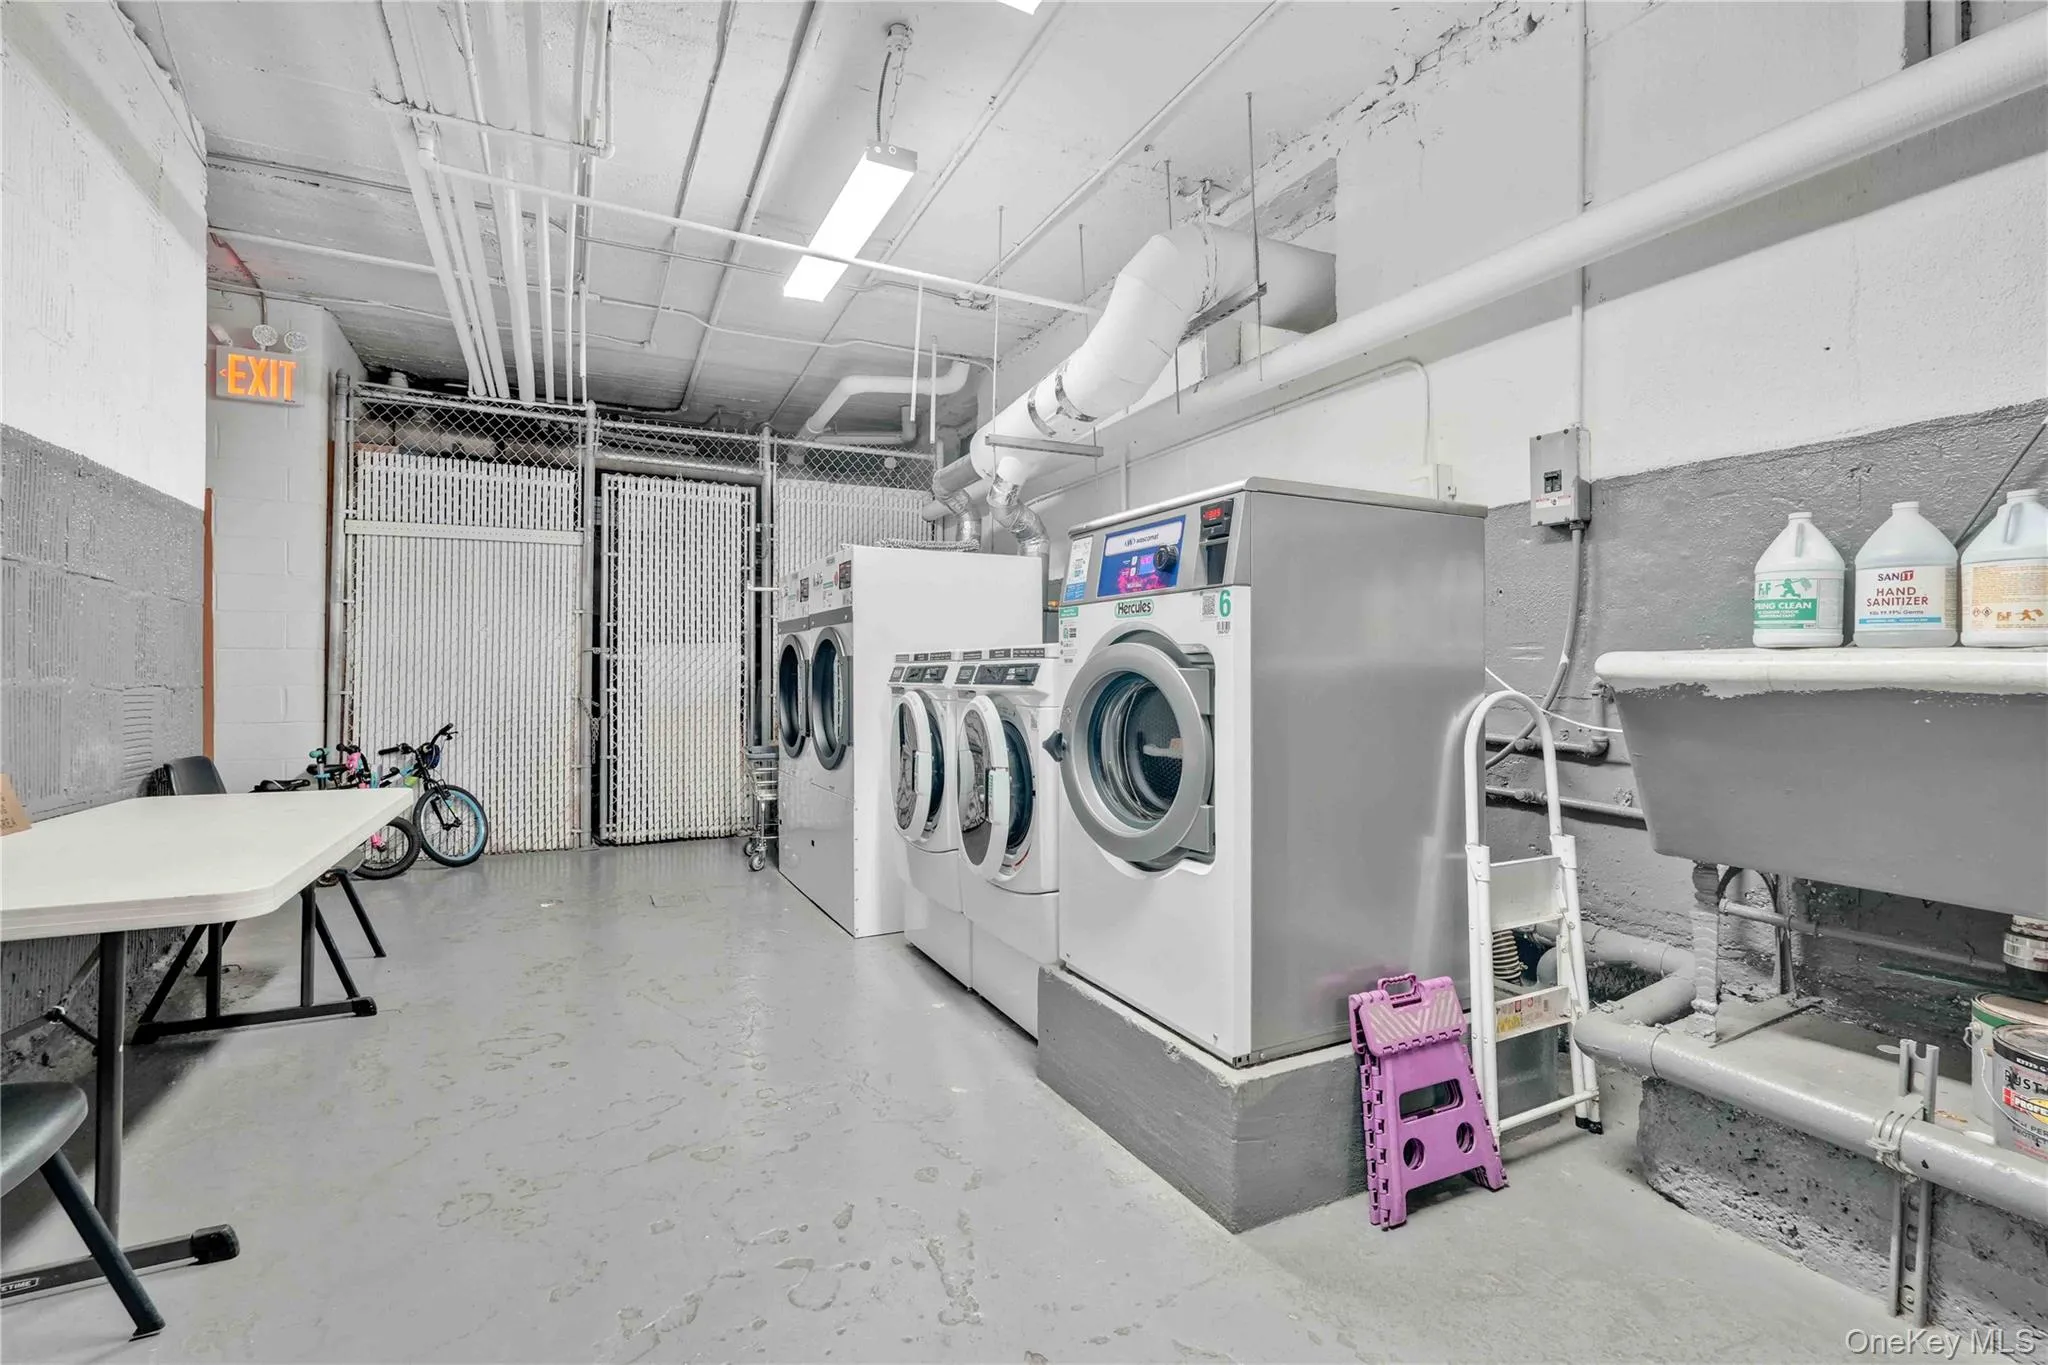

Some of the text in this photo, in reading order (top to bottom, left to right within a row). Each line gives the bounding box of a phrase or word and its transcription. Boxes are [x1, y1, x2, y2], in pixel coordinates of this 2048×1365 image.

[227, 353, 297, 401] EXIT
[1876, 586, 1917, 597] HAND
[1117, 600, 1152, 615] Hercules
[1219, 590, 1231, 618] 6
[1866, 596, 1929, 608] SANITIZER
